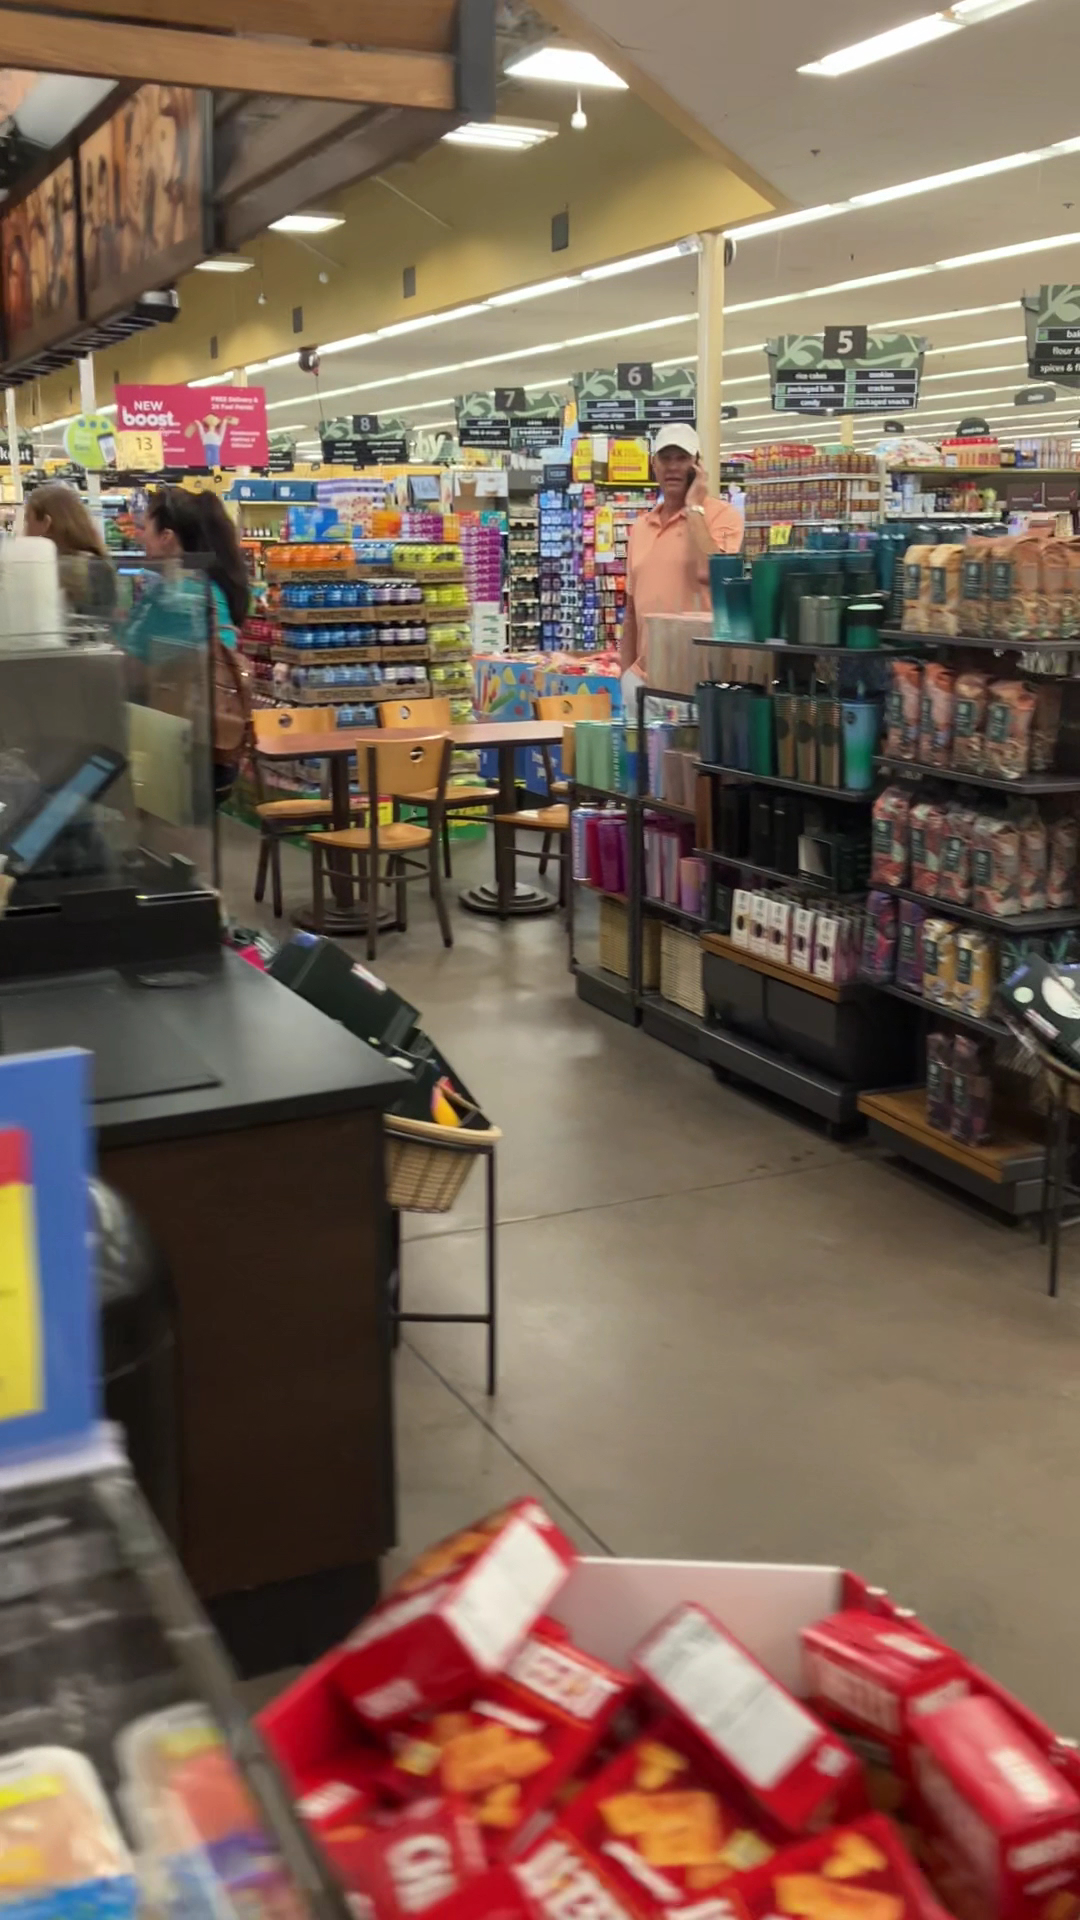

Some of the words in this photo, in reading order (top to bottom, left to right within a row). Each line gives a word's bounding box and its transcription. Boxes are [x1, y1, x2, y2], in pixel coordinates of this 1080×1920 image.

[836, 330, 854, 354] 5
[627, 366, 642, 386] 6
[133, 400, 164, 411] NEW
[504, 391, 515, 408] 7
[122, 405, 175, 427] boost
[360, 417, 371, 431] 8
[135, 437, 153, 451] 13
